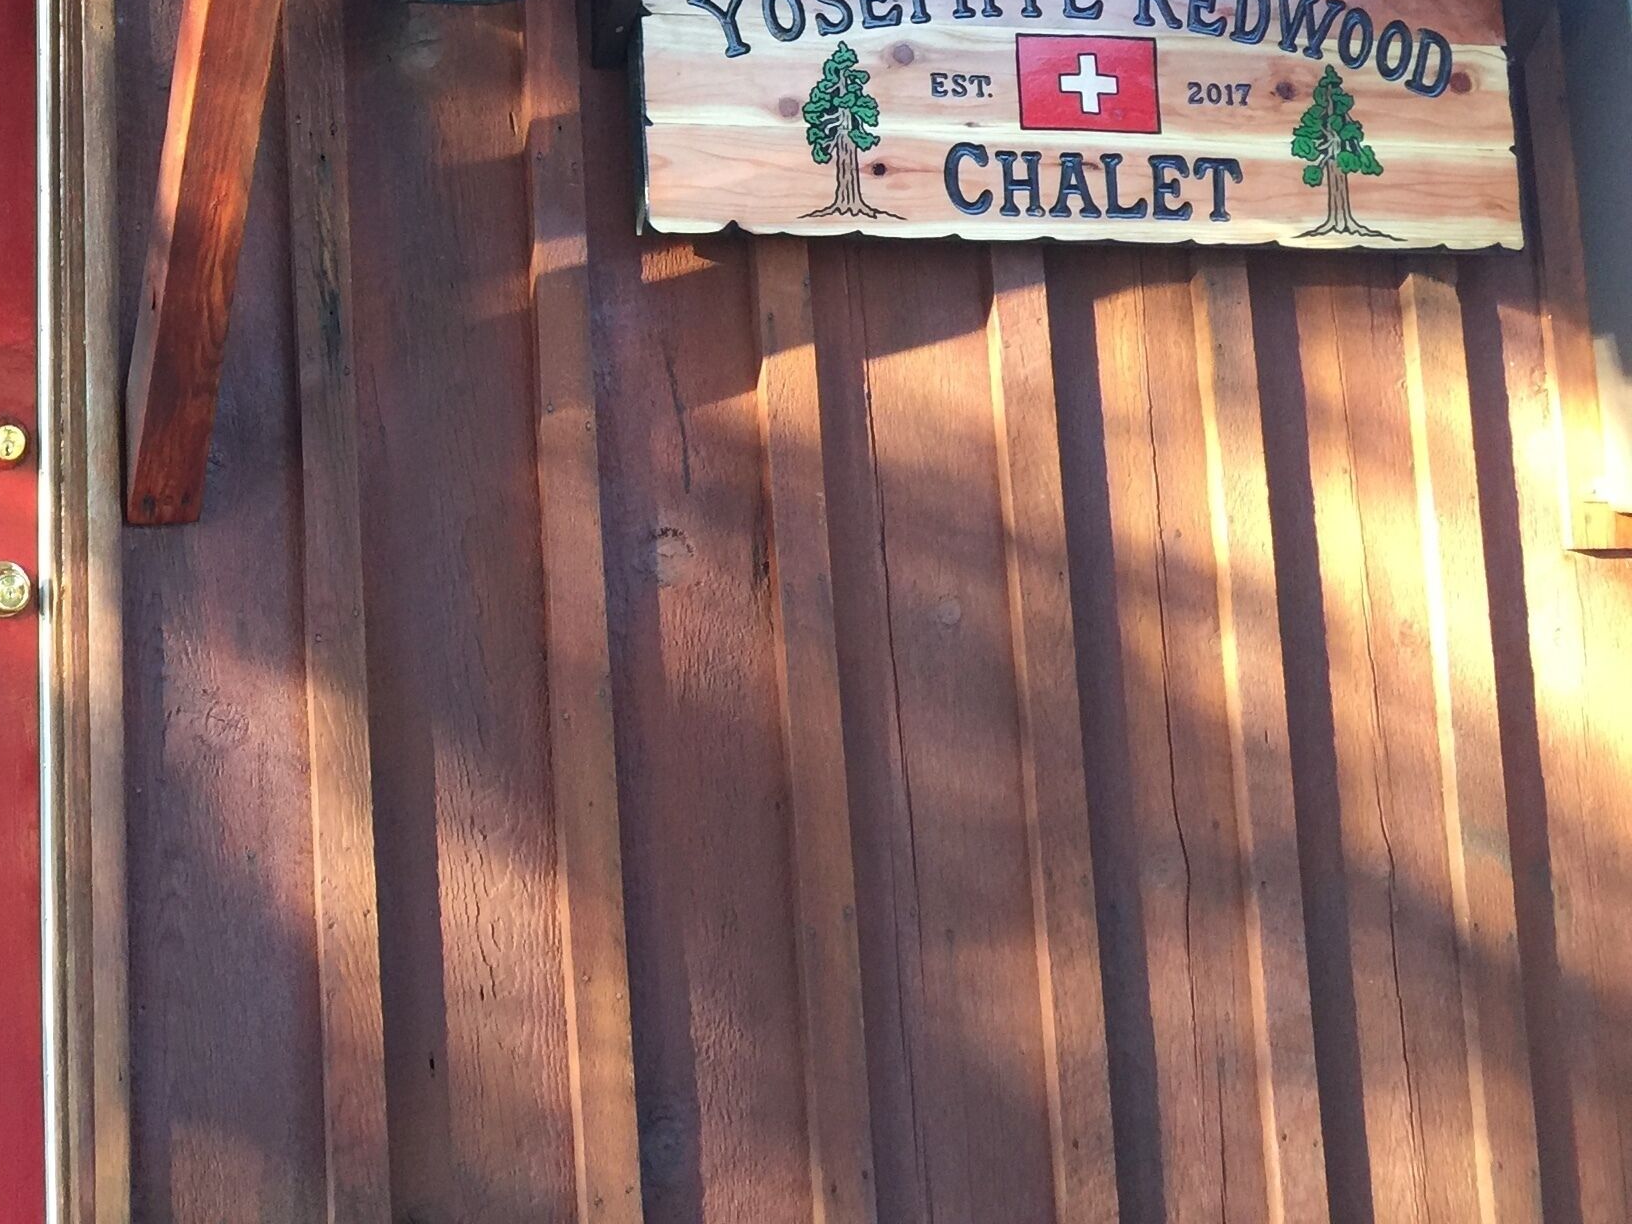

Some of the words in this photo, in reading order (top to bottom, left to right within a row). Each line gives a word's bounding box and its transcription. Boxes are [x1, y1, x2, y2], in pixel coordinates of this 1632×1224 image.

[930, 73, 993, 98] EST.
[1187, 81, 1252, 106] 2017
[944, 142, 1243, 222] CHALET
